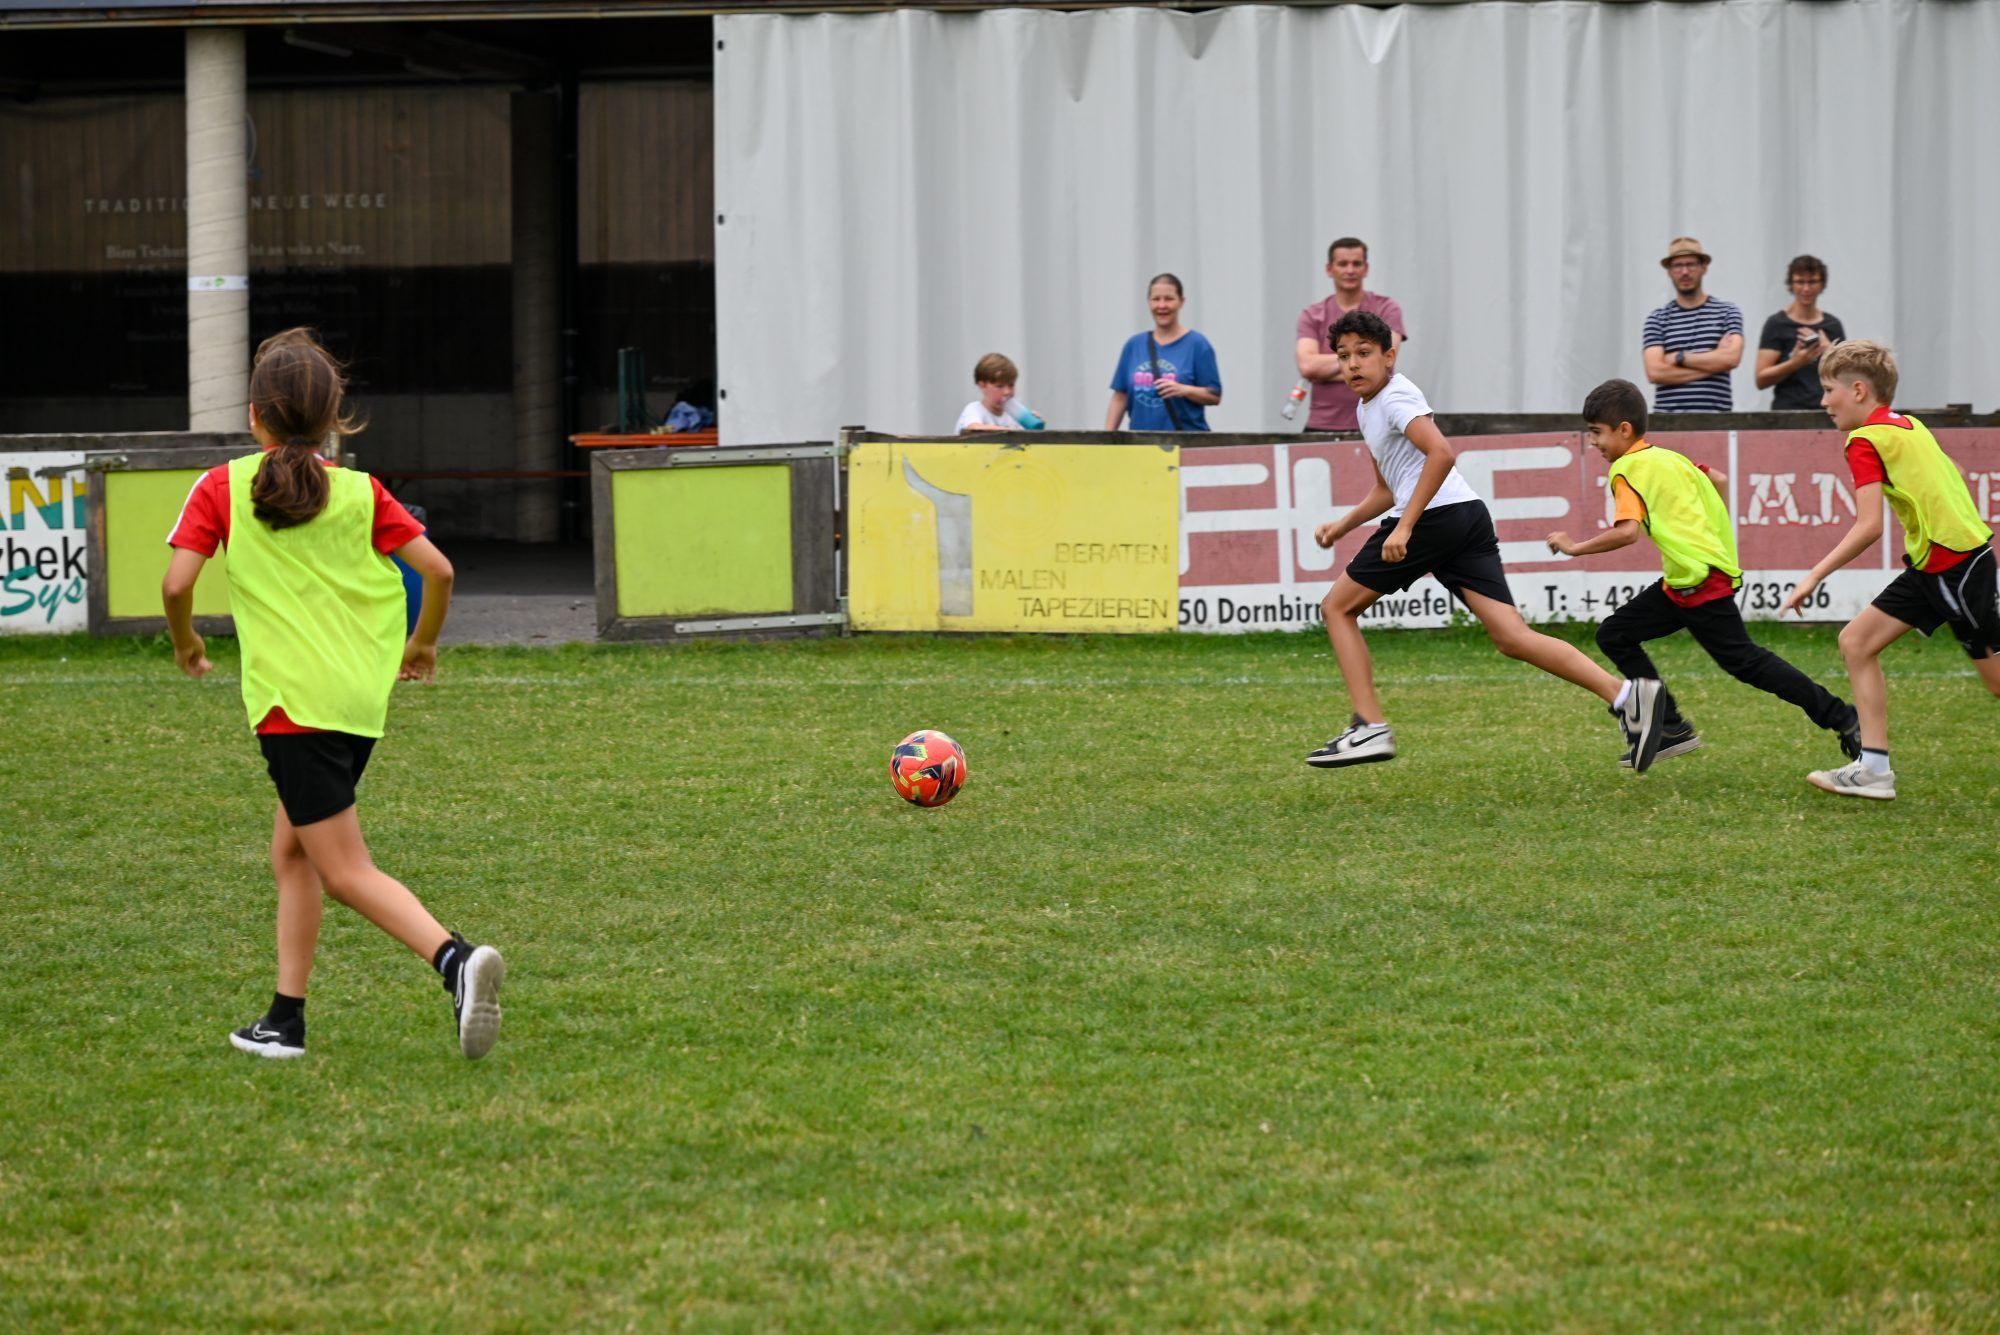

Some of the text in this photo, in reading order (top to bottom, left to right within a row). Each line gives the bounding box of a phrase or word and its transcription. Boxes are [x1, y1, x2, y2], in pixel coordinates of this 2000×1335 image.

[250, 195, 310, 210] NEUE
[324, 193, 386, 208] WEGE
[0, 536, 87, 580] bek
[1055, 543, 1168, 564] BERATEN
[980, 569, 1066, 590] MALEN
[1018, 598, 1168, 618] TAPEZIEREN
[1544, 585, 1566, 612] T:
